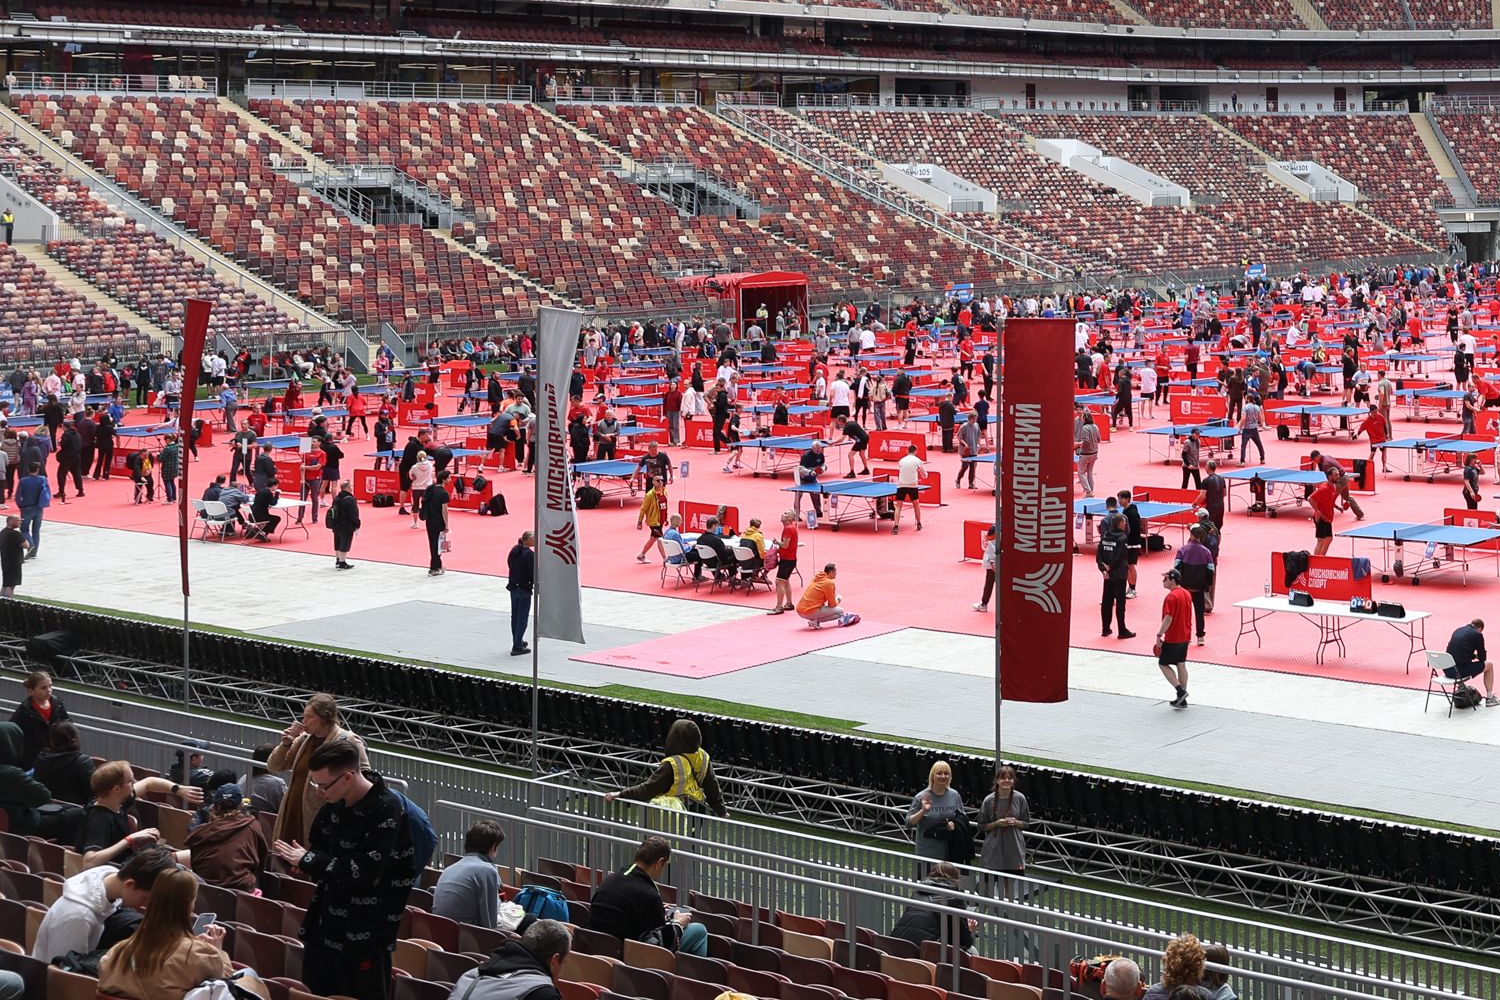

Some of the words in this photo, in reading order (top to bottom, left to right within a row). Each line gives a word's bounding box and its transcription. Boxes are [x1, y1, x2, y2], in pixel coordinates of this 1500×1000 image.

[1010, 403, 1041, 553] МОСКОВСКИЙ
[1040, 484, 1067, 553] СПОРТ
[1308, 568, 1349, 580] МОСКОВСКИЙ
[1308, 578, 1328, 588] СПОРТ
[351, 896, 378, 905] HUGO
[328, 905, 348, 918] HUGO
[346, 931, 371, 941] HUGO
[324, 938, 344, 951] HUGO
